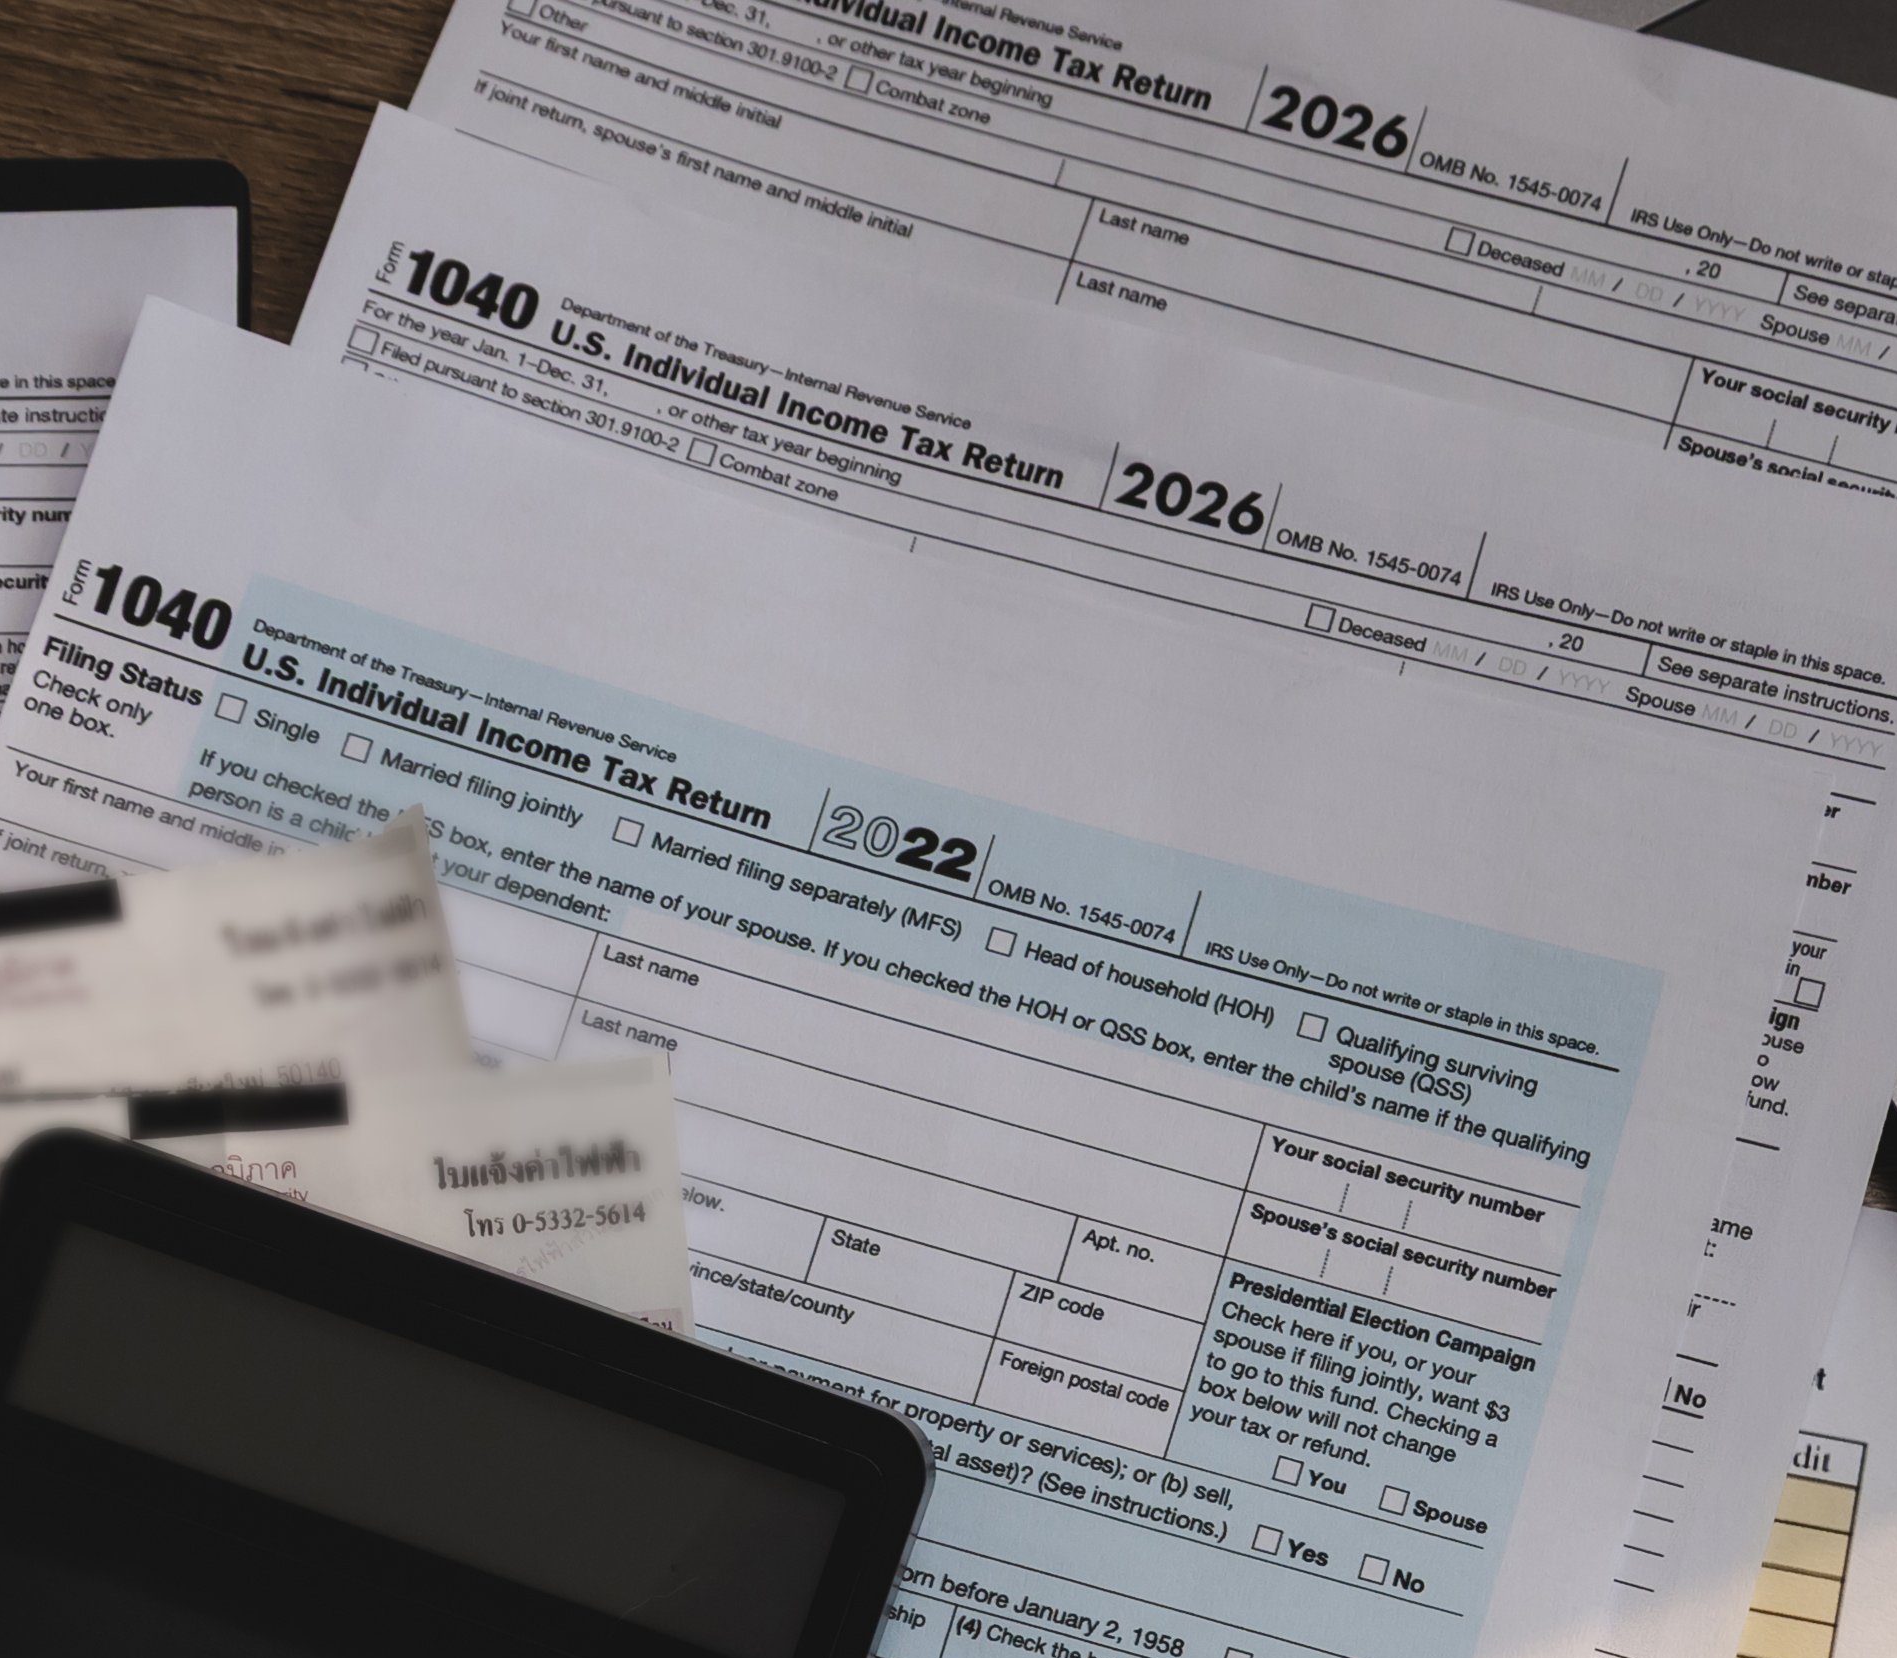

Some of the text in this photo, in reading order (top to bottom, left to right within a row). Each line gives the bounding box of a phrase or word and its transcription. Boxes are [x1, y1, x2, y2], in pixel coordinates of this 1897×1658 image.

[1261, 87, 1408, 158] 2026
[1098, 207, 1190, 246] Last name
[1702, 367, 1748, 393] Your
[1750, 385, 1810, 410] social
[1812, 401, 1892, 434] security
[719, 453, 839, 502] Combat zone
[62, 559, 232, 650] Form 1040
[1338, 616, 1428, 653] Deceased
[43, 635, 204, 706] Filing Status
[1657, 655, 1894, 725] See separate instructions.
[254, 708, 320, 744] Single
[380, 747, 584, 829] Married filing jointly
[822, 807, 978, 883] 2022
[463, 1202, 646, 1238] โทร 0-5332-5614
[831, 1228, 881, 1257] State
[1081, 1229, 1154, 1263] Apt. no.
[1019, 1282, 1105, 1321] ZIP code
[1228, 1271, 1536, 1372] Presidential Election Campaign
[1309, 1469, 1347, 1495] You
[1412, 1499, 1488, 1534] Spouse
[1288, 1538, 1329, 1567] Yes
[1392, 1568, 1425, 1594] No
